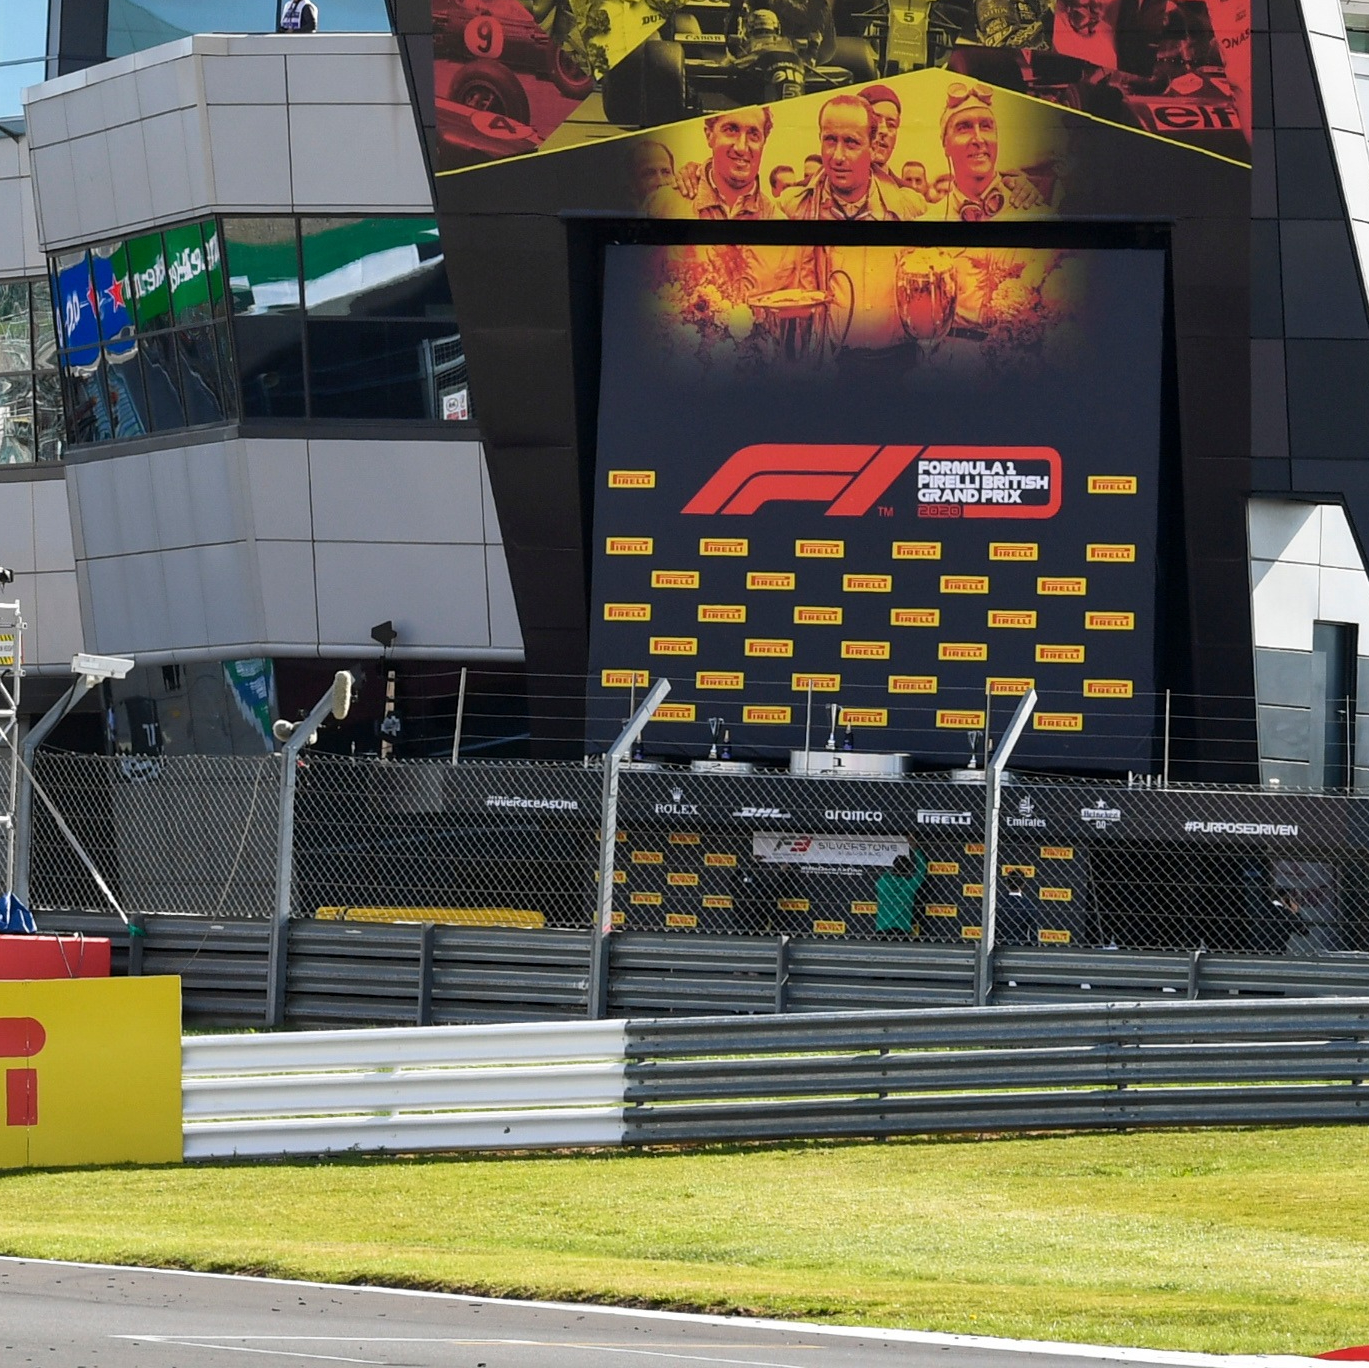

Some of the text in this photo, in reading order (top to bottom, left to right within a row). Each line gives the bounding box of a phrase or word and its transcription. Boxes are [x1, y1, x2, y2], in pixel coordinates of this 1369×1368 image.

[903, 12, 915, 23] 5
[476, 20, 494, 53] 9
[1153, 105, 1236, 128] elf
[917, 460, 1017, 476] FORMULA 1
[612, 474, 651, 485] PIRELLI
[917, 475, 1050, 491] PIRELLI BRITISH
[1092, 479, 1133, 491] PIRELLI
[917, 489, 1023, 504] GRAND PRIX
[917, 505, 962, 518] 2020
[610, 540, 649, 551] PIRELLI
[704, 541, 744, 553] PIRELLI
[799, 543, 840, 555] PIRELLI
[896, 545, 937, 556] PIRELLI
[993, 546, 1034, 557] PIRELLI
[1090, 547, 1131, 559] PIRELLI
[655, 574, 695, 585] PIRELLI
[750, 575, 791, 587] PIRELLI
[847, 577, 888, 589] PIRELLI
[944, 579, 985, 590] PIRELLI
[1041, 580, 1082, 592] PIRELLI
[608, 607, 647, 618] PIRELLI
[702, 608, 742, 619] PIRELLI
[798, 609, 838, 621] PIRELLI
[895, 612, 936, 623] PIRELLI
[992, 613, 1033, 625] PIRELLI
[1089, 615, 1130, 627] PIRELLI
[654, 640, 693, 652] PIRELLI
[749, 642, 789, 654] PIRELLI
[845, 644, 886, 656] PIRELLI
[942, 646, 983, 657] PIRELLI
[1039, 648, 1080, 660] PIRELLI
[700, 675, 740, 686] PIRELLI
[893, 679, 933, 690] PIRELLI
[1087, 683, 1129, 695] PIRELLI
[747, 709, 787, 720] PIRELLI
[940, 713, 981, 725] PIRELLI
[1037, 715, 1078, 727] PIRELLI
[655, 803, 699, 815] ROLEX
[737, 806, 786, 819] DHL
[824, 809, 883, 822] aramco
[916, 809, 972, 825] PIRELLI
[1006, 815, 1046, 829] Emirates
[1184, 820, 1299, 837] #PURPOSEDRIVEN
